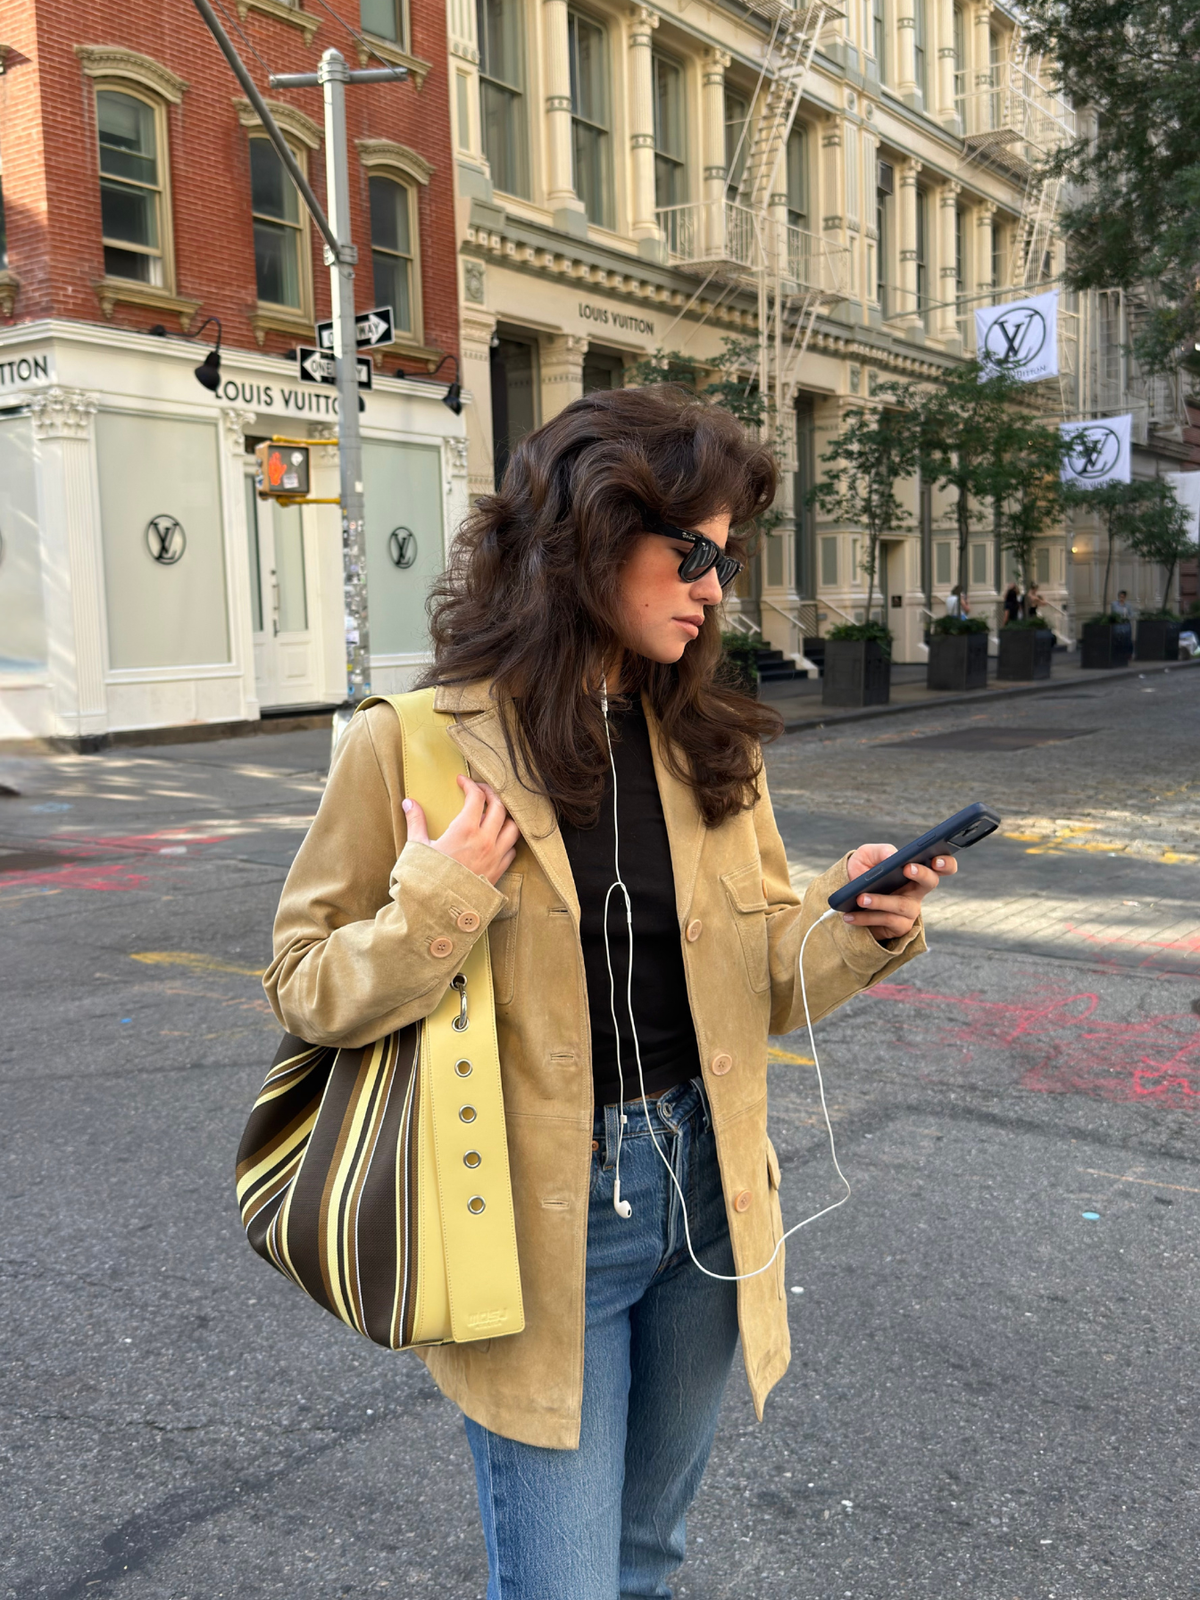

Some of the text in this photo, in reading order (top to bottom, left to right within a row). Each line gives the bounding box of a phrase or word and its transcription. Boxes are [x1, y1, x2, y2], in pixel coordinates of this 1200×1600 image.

[578, 303, 655, 336] LOUIS VUITTON
[356, 320, 381, 340] WAY
[310, 360, 333, 377] ONE
[1012, 364, 1047, 378] UITTON
[280, 388, 339, 415] VUITTO
